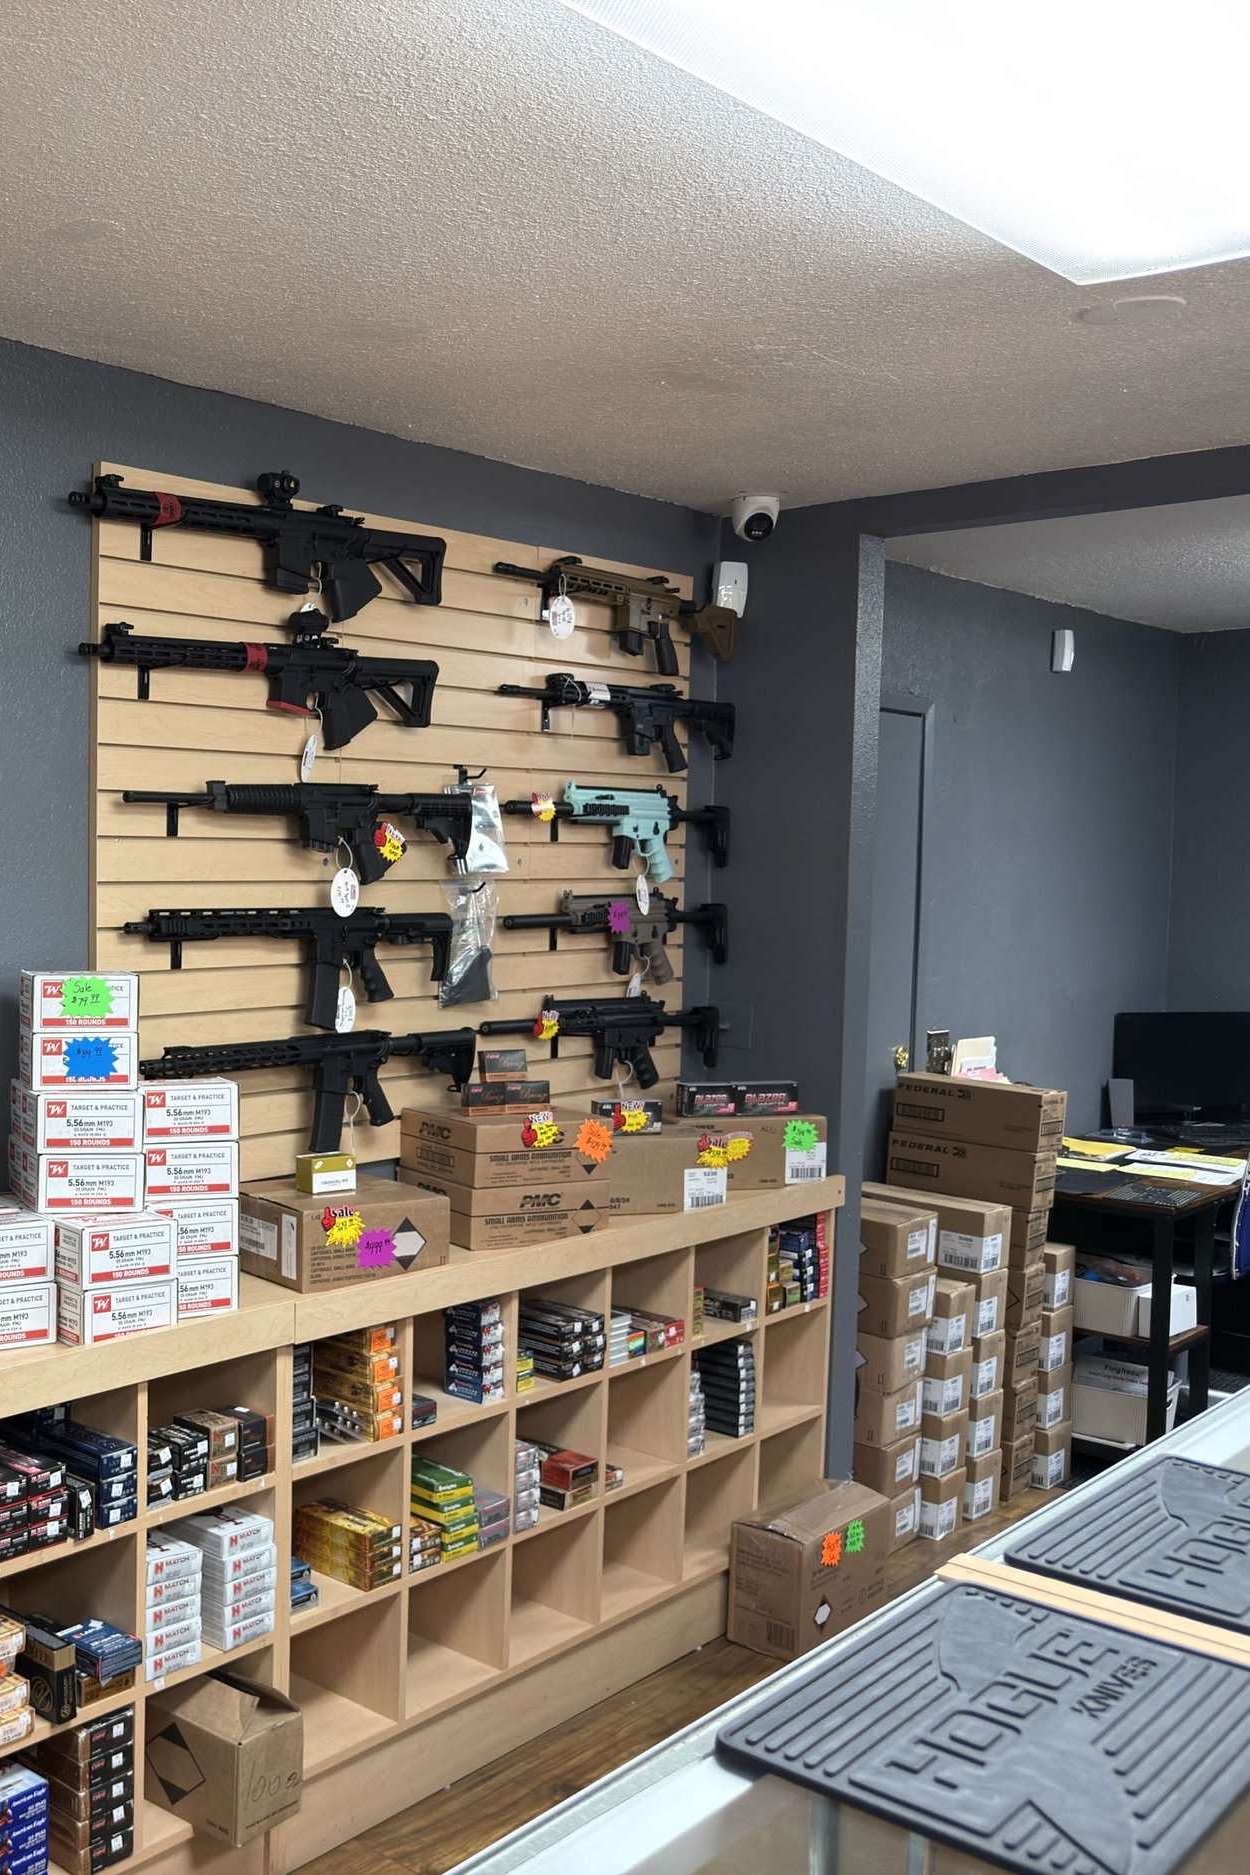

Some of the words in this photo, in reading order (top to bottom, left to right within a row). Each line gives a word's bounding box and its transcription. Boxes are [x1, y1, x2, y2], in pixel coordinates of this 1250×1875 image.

[74, 981, 92, 993] Sale
[897, 1083, 954, 1097] FEDERAL
[419, 1121, 451, 1140] PMC
[892, 1139, 949, 1154] FEDERAL
[519, 1193, 562, 1208] PMC
[332, 1206, 354, 1218] sale
[485, 1216, 505, 1225] SMALL
[507, 1215, 526, 1224] ARMS
[527, 1213, 568, 1223] AMMUNITION
[14, 1233, 41, 1241] PRACTICE
[12, 1250, 28, 1258] M193
[165, 1556, 190, 1566] MATCH
[164, 1579, 189, 1590] MATCH
[165, 1626, 190, 1639] MATCH
